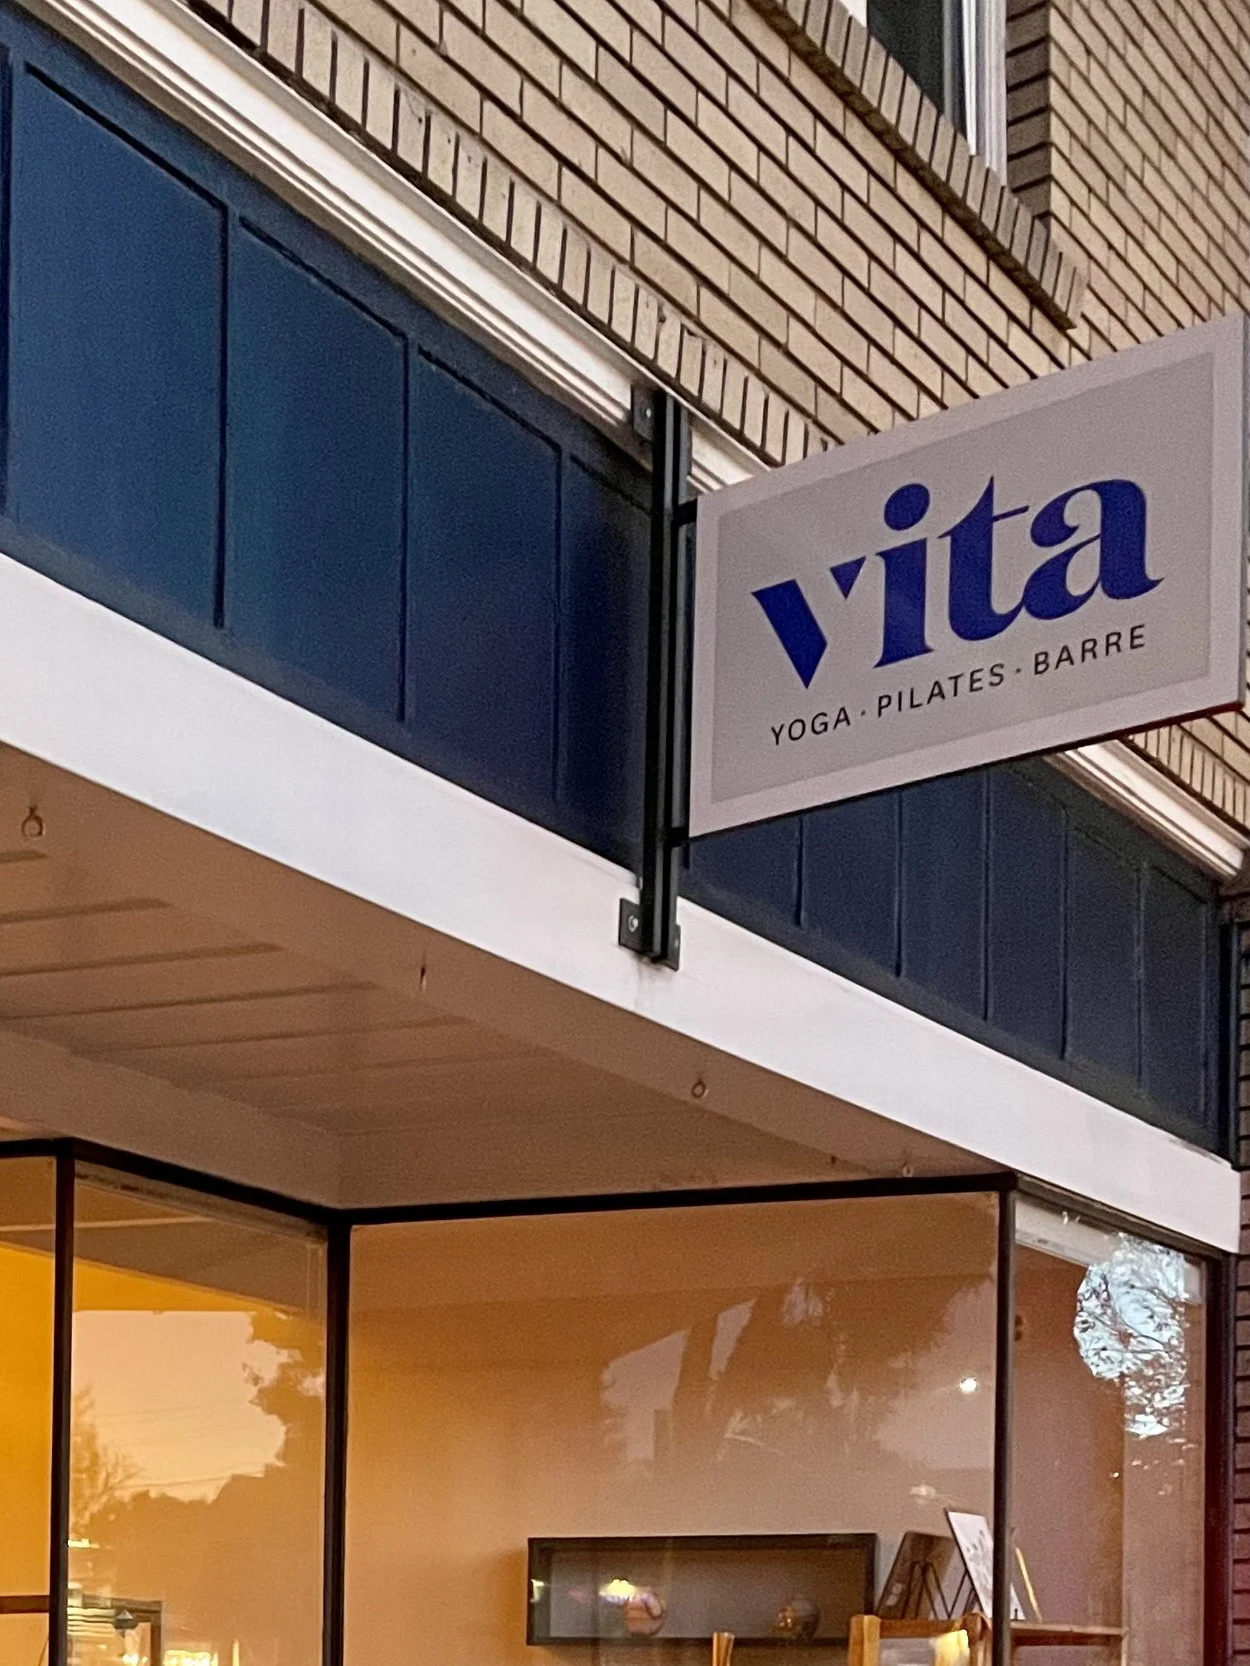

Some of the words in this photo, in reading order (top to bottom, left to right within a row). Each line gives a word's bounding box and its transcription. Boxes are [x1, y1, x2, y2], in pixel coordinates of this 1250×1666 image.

[751, 474, 1165, 690] vita
[770, 706, 851, 746] YOGA
[876, 662, 1006, 718] PILATES
[1033, 623, 1147, 676] BARRE
